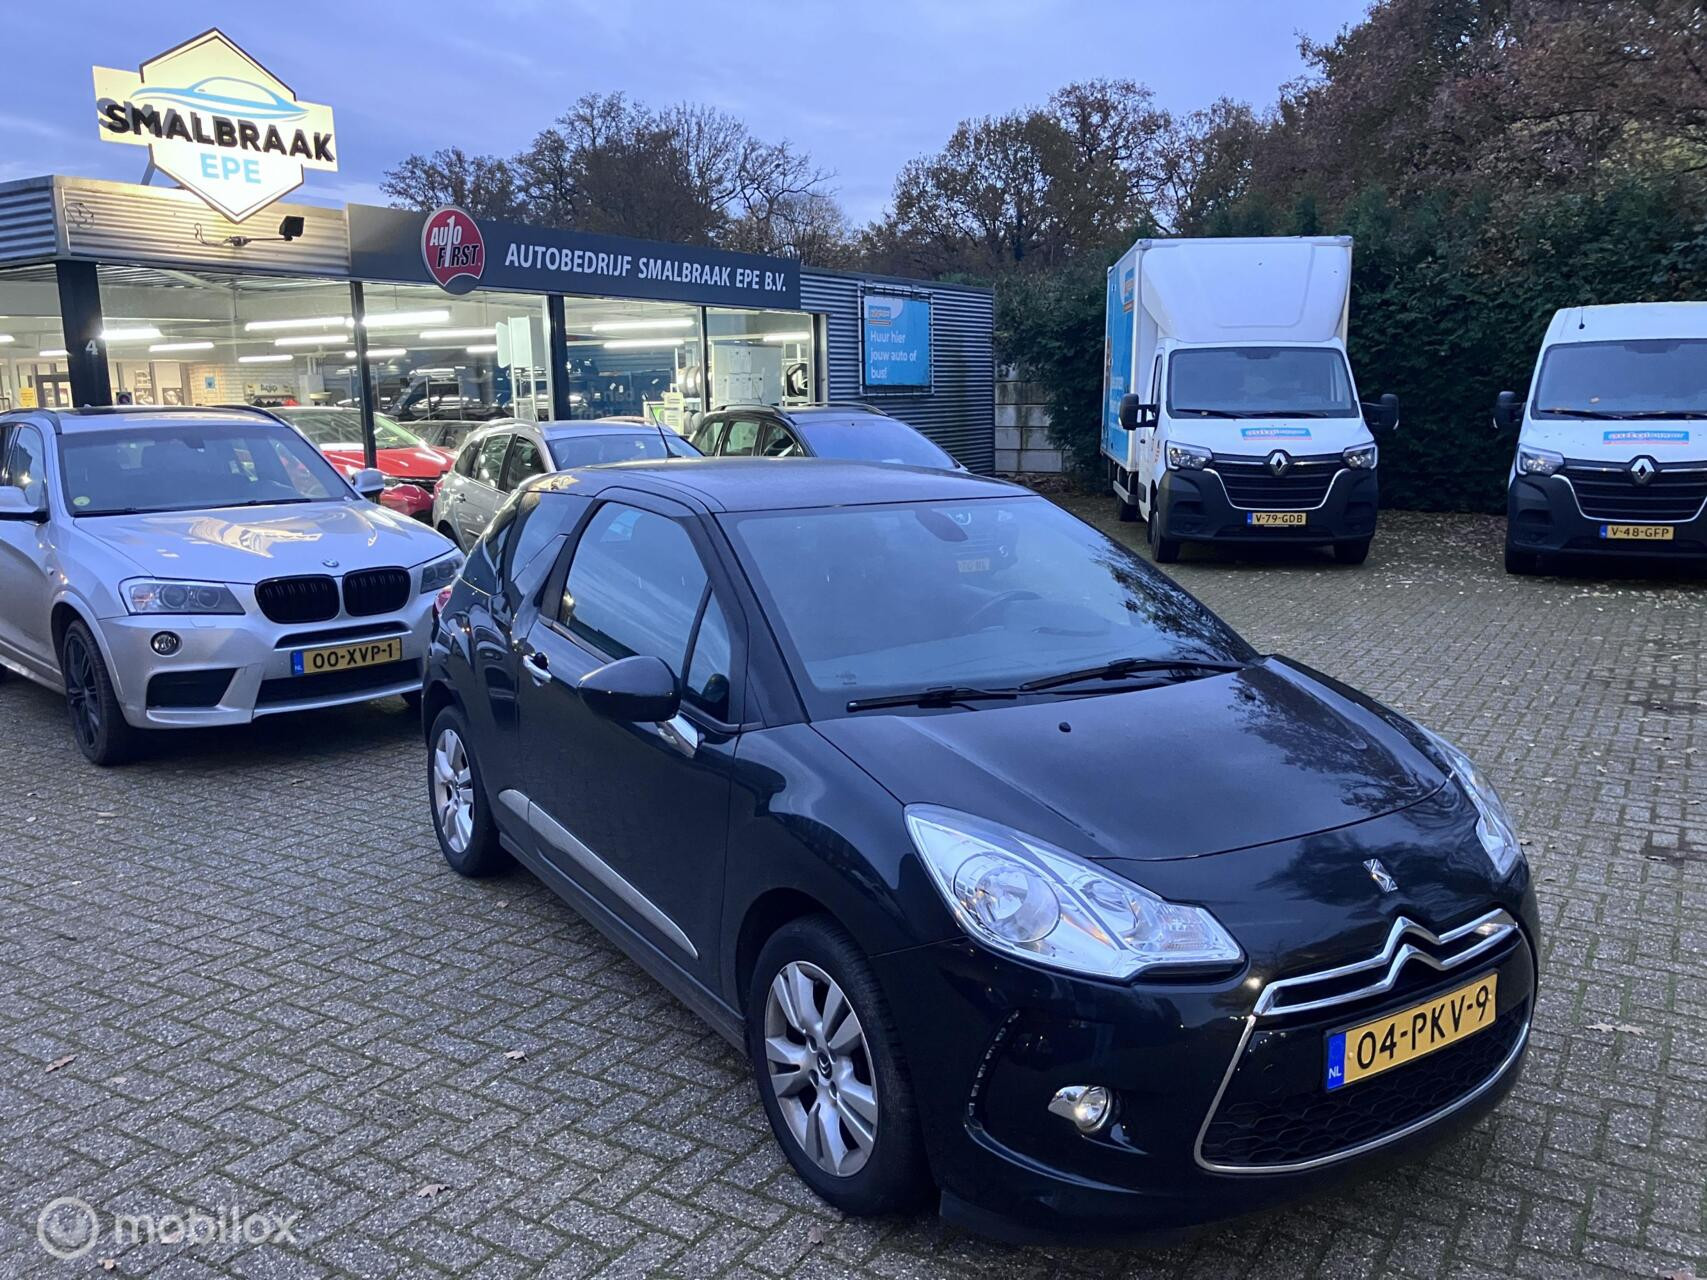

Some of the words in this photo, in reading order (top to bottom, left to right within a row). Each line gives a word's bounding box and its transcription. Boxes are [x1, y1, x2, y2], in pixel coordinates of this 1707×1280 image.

[100, 102, 336, 163] SMALBRAAK
[199, 152, 262, 185] EPE
[504, 242, 632, 278] AUTOBEDRIJF
[637, 256, 731, 287] SMALBRAAK
[735, 267, 760, 290] EPE
[764, 271, 787, 292] B.V.
[85, 339, 99, 355] 4
[869, 330, 889, 343] Huur
[891, 330, 906, 344] hier
[869, 347, 889, 363] jouw
[890, 350, 908, 362] auto
[909, 349, 918, 362] of
[1255, 514, 1304, 524] V-79-GDB
[1611, 526, 1670, 538] V-48-GFP
[312, 642, 394, 670] 00-XVP-1
[1328, 1065, 1342, 1080] NL
[1356, 984, 1490, 1070] 04-PKV-9
